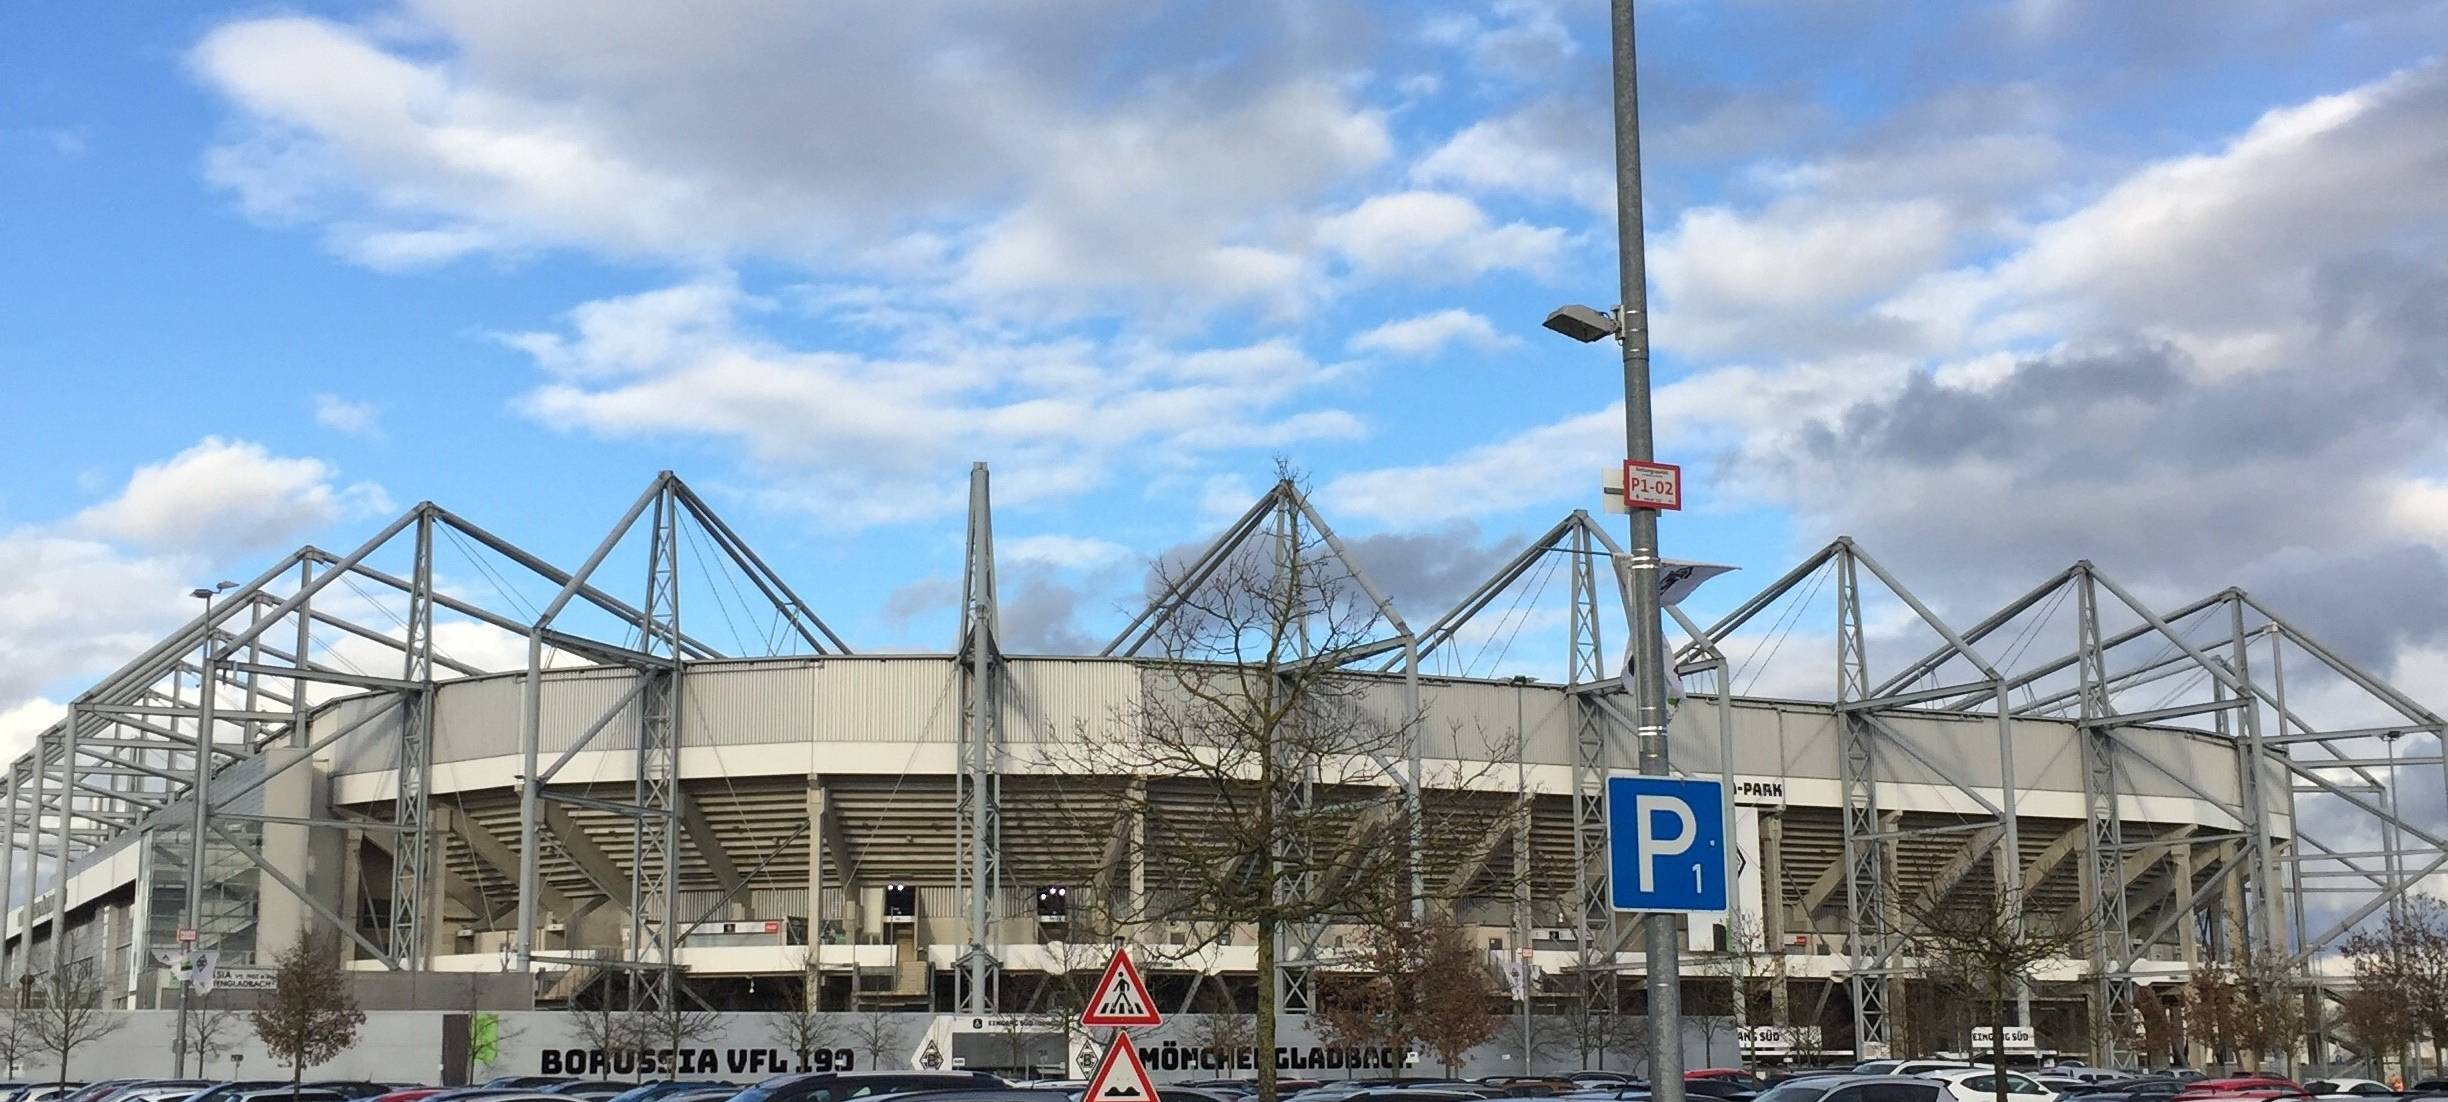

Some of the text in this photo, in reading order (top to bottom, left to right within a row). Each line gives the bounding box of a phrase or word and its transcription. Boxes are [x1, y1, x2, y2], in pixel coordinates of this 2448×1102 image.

[1631, 477, 1674, 496] P1-02
[1636, 794, 1697, 893] P
[1692, 863, 1702, 894] 1
[1760, 1030, 1780, 1042] SÜD
[2012, 1030, 2029, 1041] SÜD
[541, 1049, 718, 1074] BORUSSIA
[727, 1049, 788, 1073] VFL
